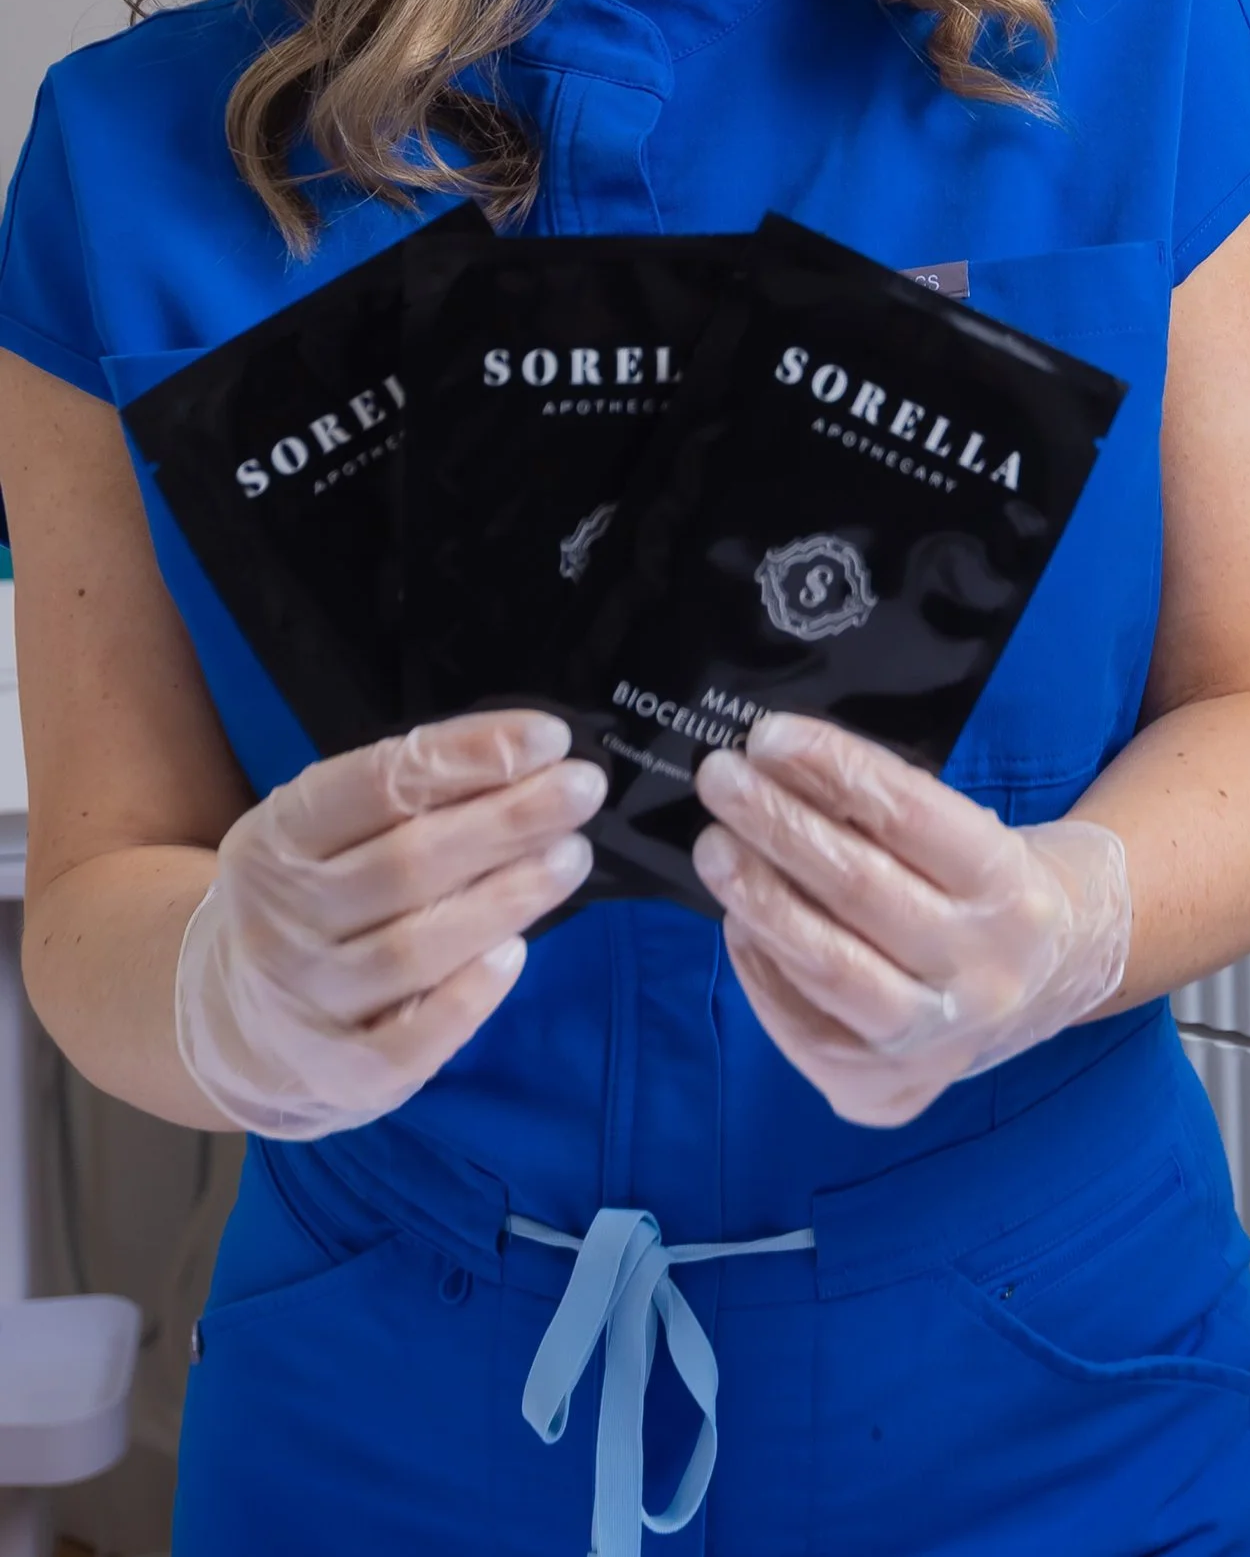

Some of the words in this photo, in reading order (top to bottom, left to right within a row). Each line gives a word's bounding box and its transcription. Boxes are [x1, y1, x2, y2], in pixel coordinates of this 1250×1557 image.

[775, 346, 1021, 491] SORELLA
[811, 417, 957, 493] APOTHECARY
[314, 429, 406, 495] APOTHE
